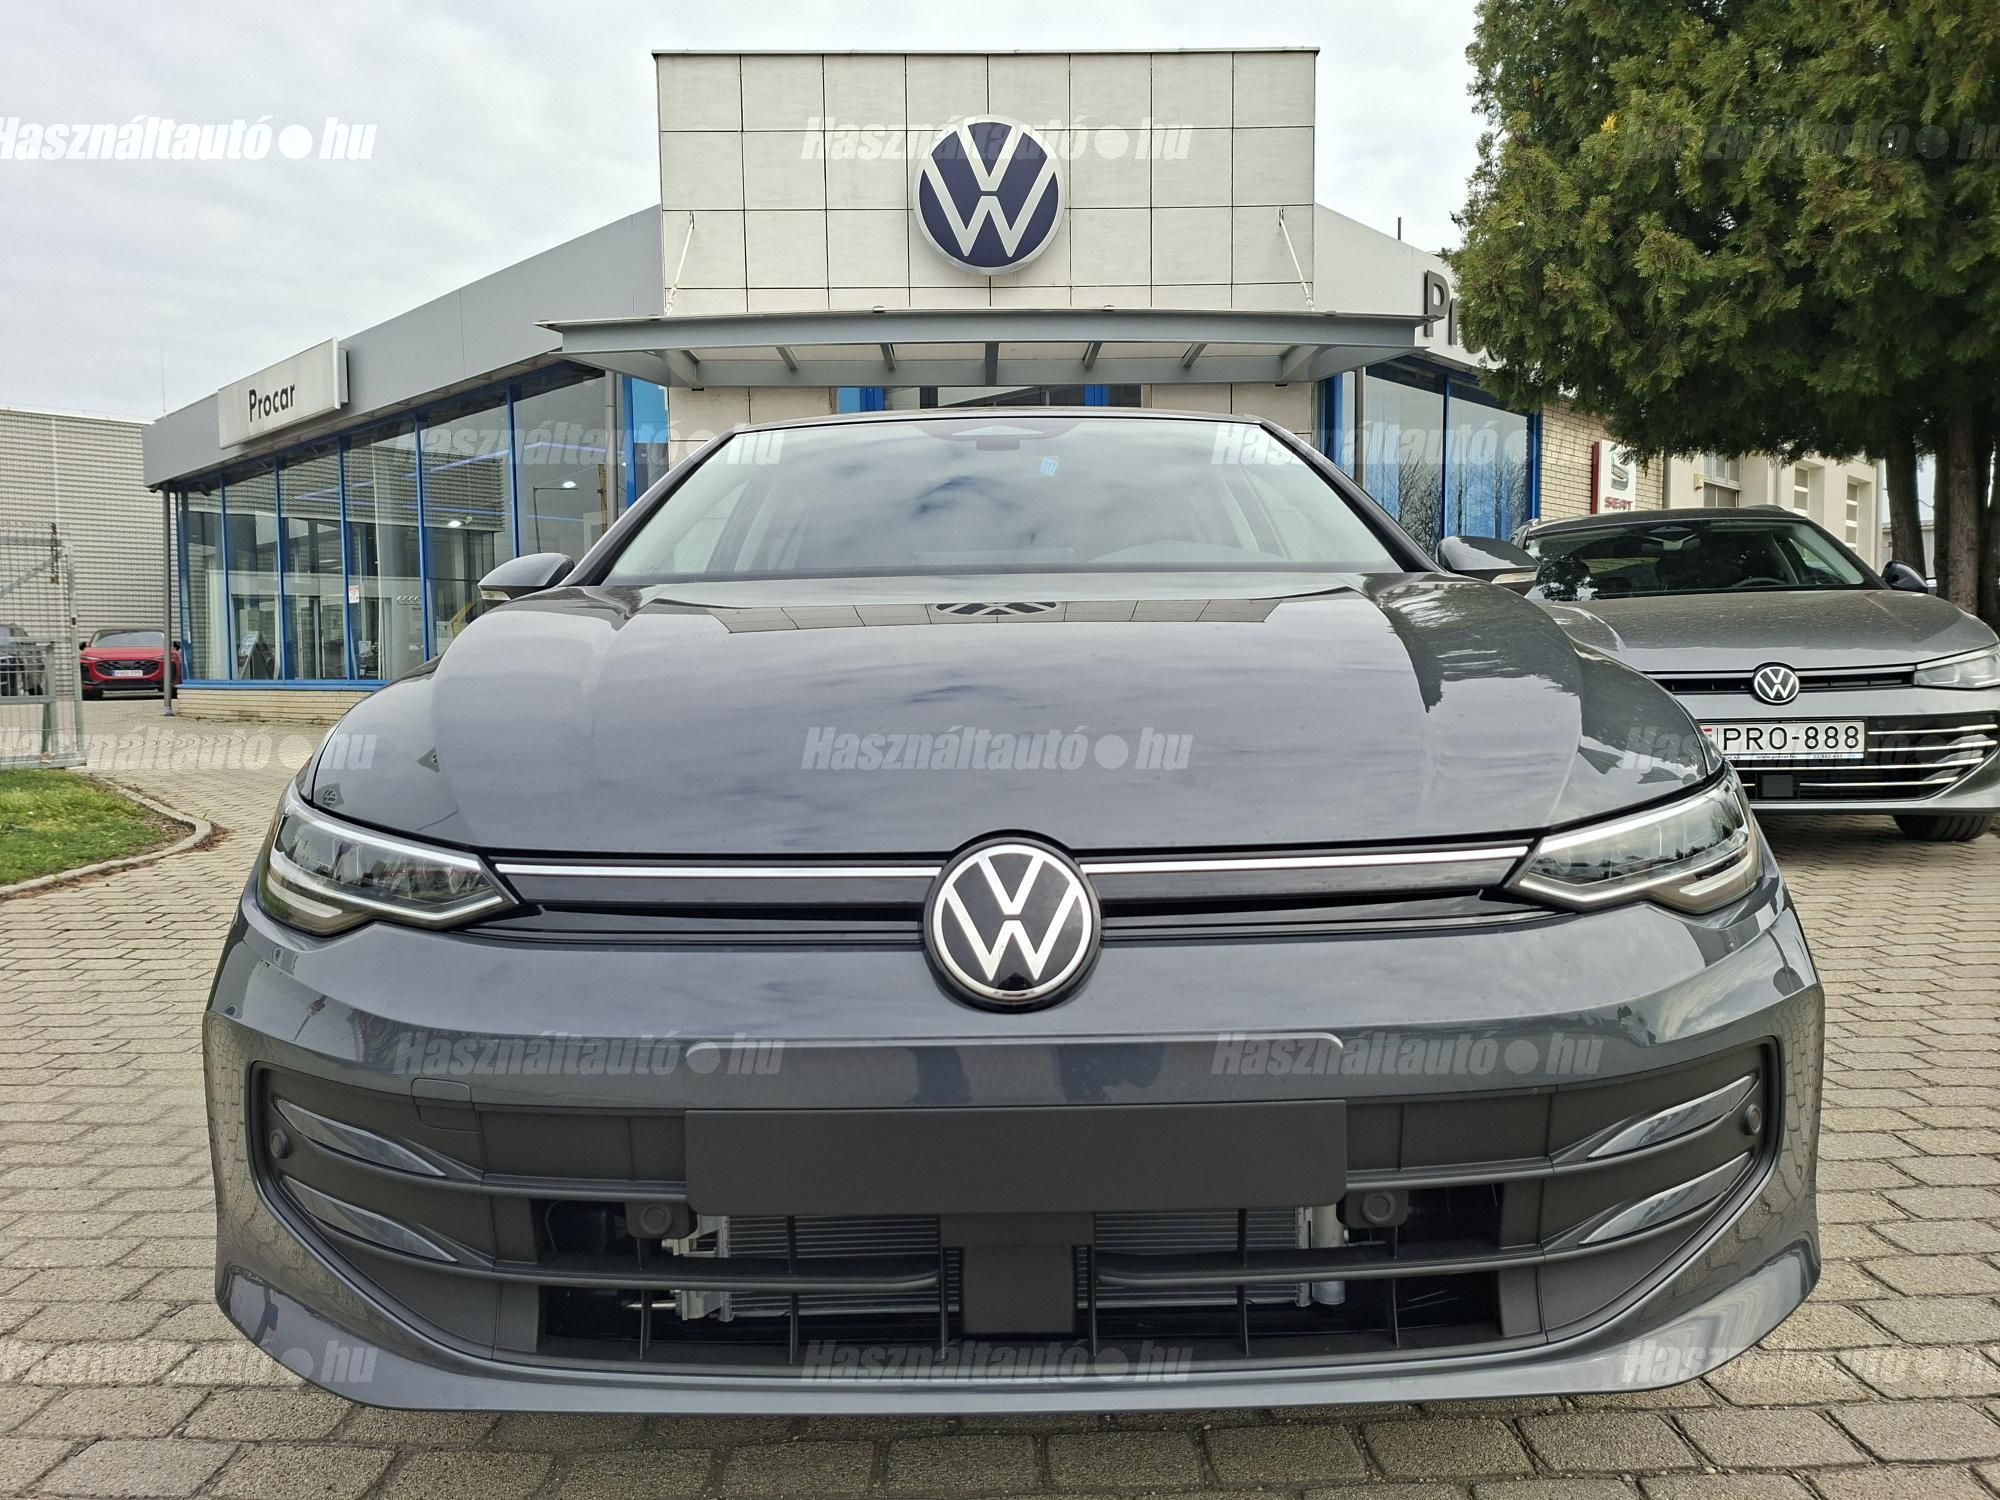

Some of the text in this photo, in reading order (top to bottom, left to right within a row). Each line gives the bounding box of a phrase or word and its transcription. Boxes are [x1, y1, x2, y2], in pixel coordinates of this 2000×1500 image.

[249, 384, 295, 422] Procar
[1605, 496, 1633, 512] SEAT
[1723, 725, 1859, 751] PRO-888
